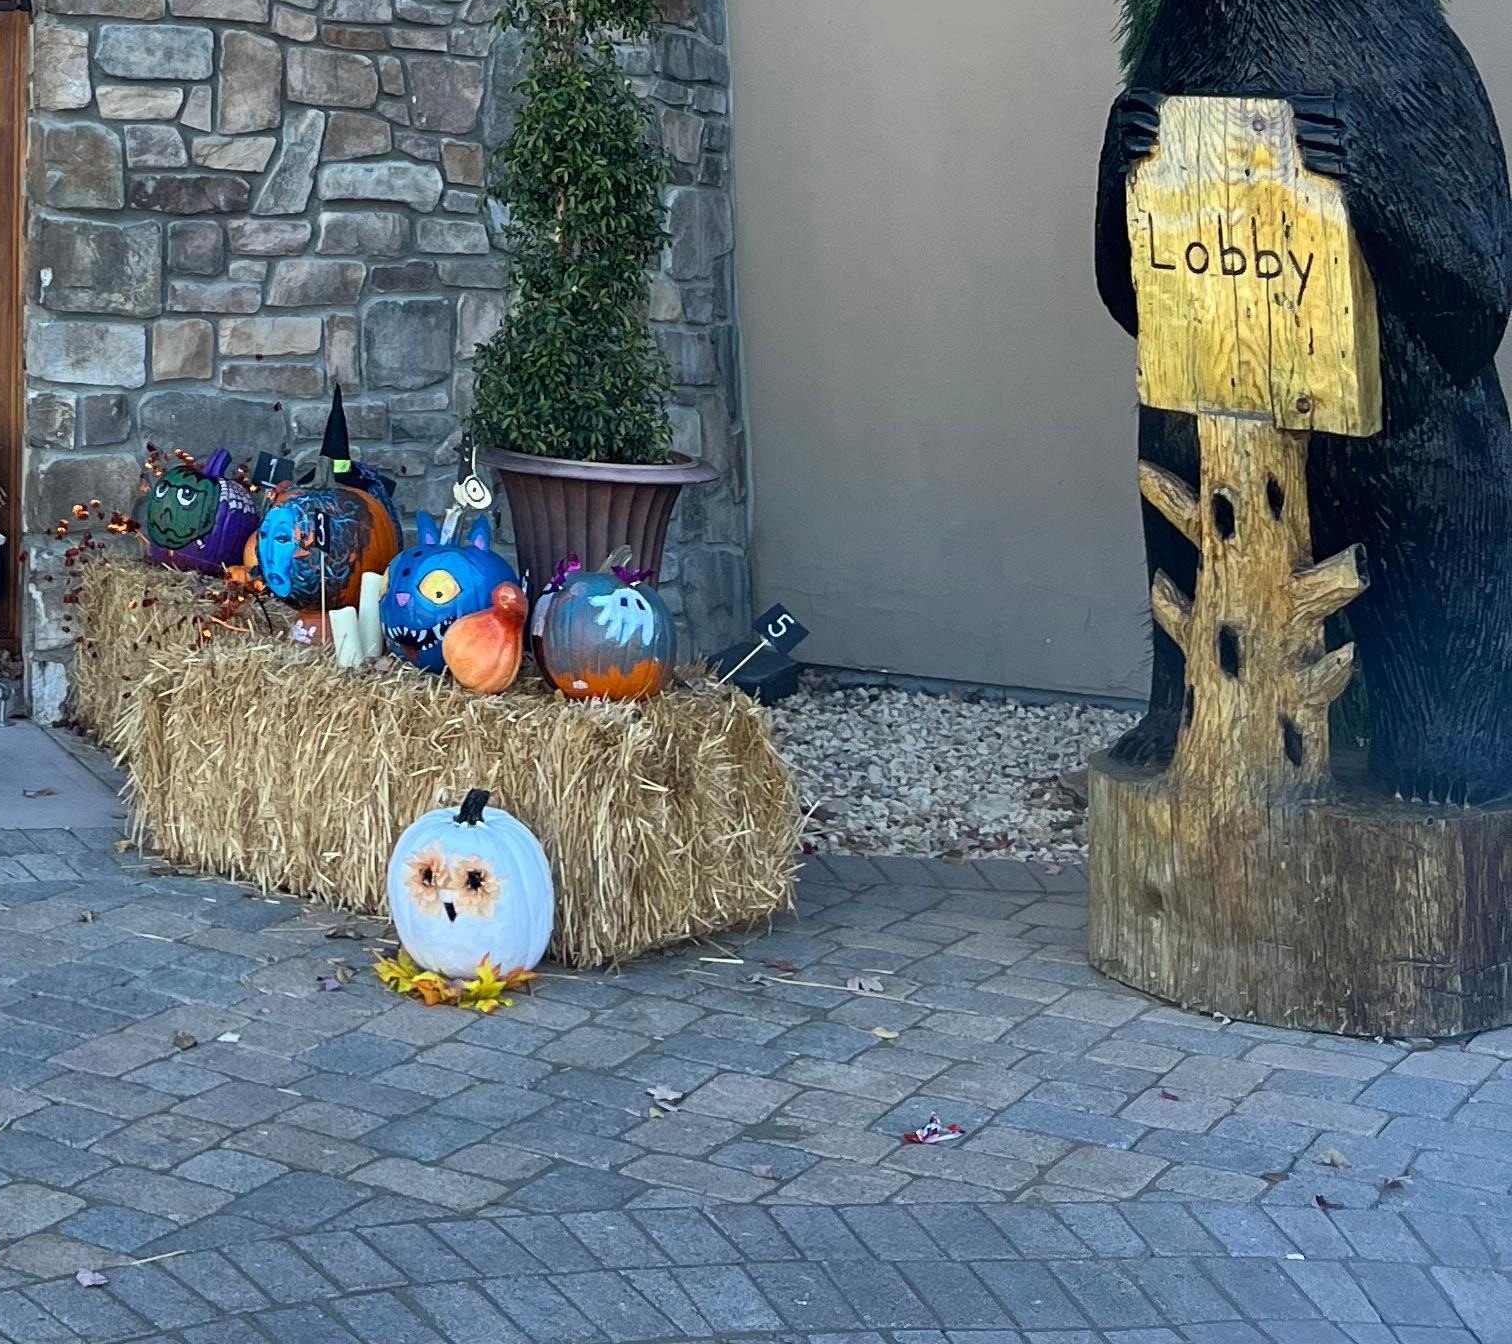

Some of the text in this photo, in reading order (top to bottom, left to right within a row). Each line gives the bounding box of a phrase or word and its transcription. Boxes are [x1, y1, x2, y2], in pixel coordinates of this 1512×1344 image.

[1148, 213, 1314, 305] Lobby
[317, 513, 326, 546] 3
[768, 613, 795, 638] 5
